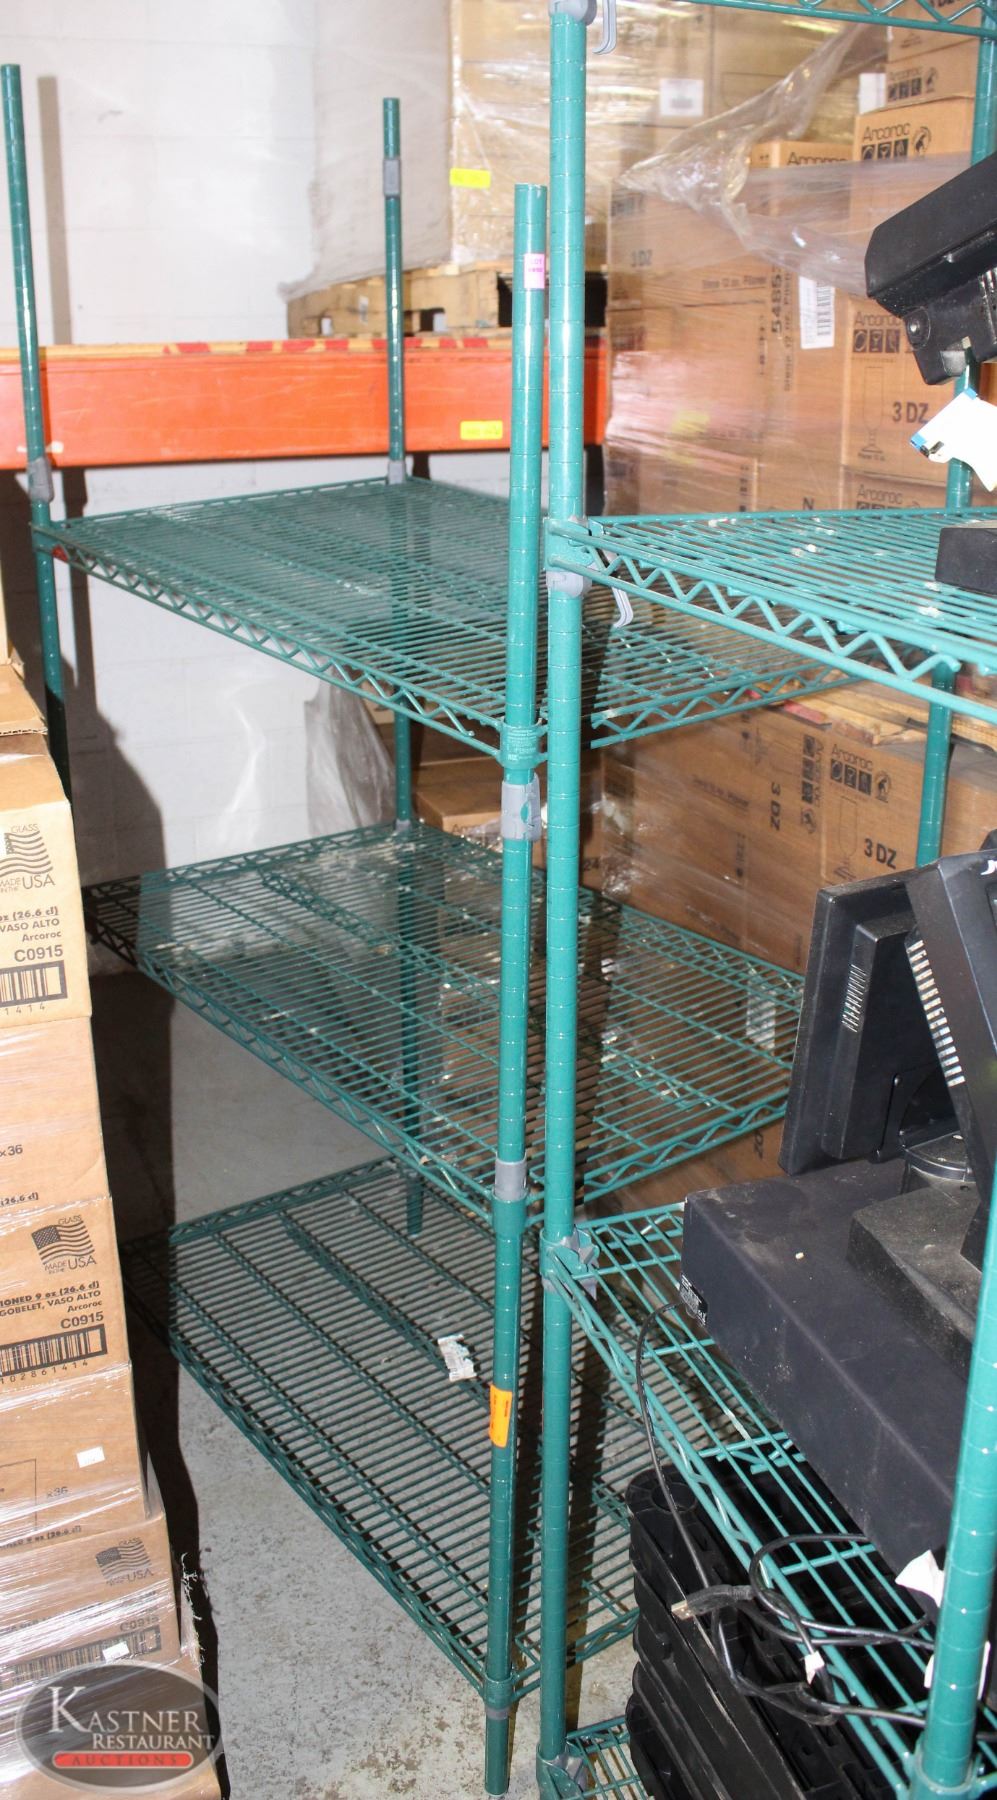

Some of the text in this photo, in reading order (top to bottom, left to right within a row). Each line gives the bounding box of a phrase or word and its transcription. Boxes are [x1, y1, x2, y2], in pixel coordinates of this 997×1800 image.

[863, 122, 911, 142] Arcoroc
[892, 401, 930, 424] 3 DZ
[857, 484, 904, 505] Arcoroc
[832, 743, 874, 770] Arcoroc
[771, 782, 781, 796] 3
[11, 824, 39, 834] GLASS
[864, 838, 898, 869] 3 DZ
[22, 874, 56, 890] USA
[13, 909, 42, 921] (26.6
[0, 918, 60, 933] VASO ALTO
[22, 930, 62, 942] Arcoroc
[14, 945, 64, 963] C0915
[58, 1215, 82, 1226] GLASS
[45, 1262, 66, 1272] MADE
[68, 1254, 97, 1270] USA
[35, 1293, 42, 1301] 9
[59, 1285, 82, 1298] (26.6
[0, 1290, 101, 1317] GOBELET, VASO ALTO
[67, 1301, 103, 1313] Arcoroc
[60, 1311, 105, 1330] C0915
[127, 1568, 154, 1583] USA
